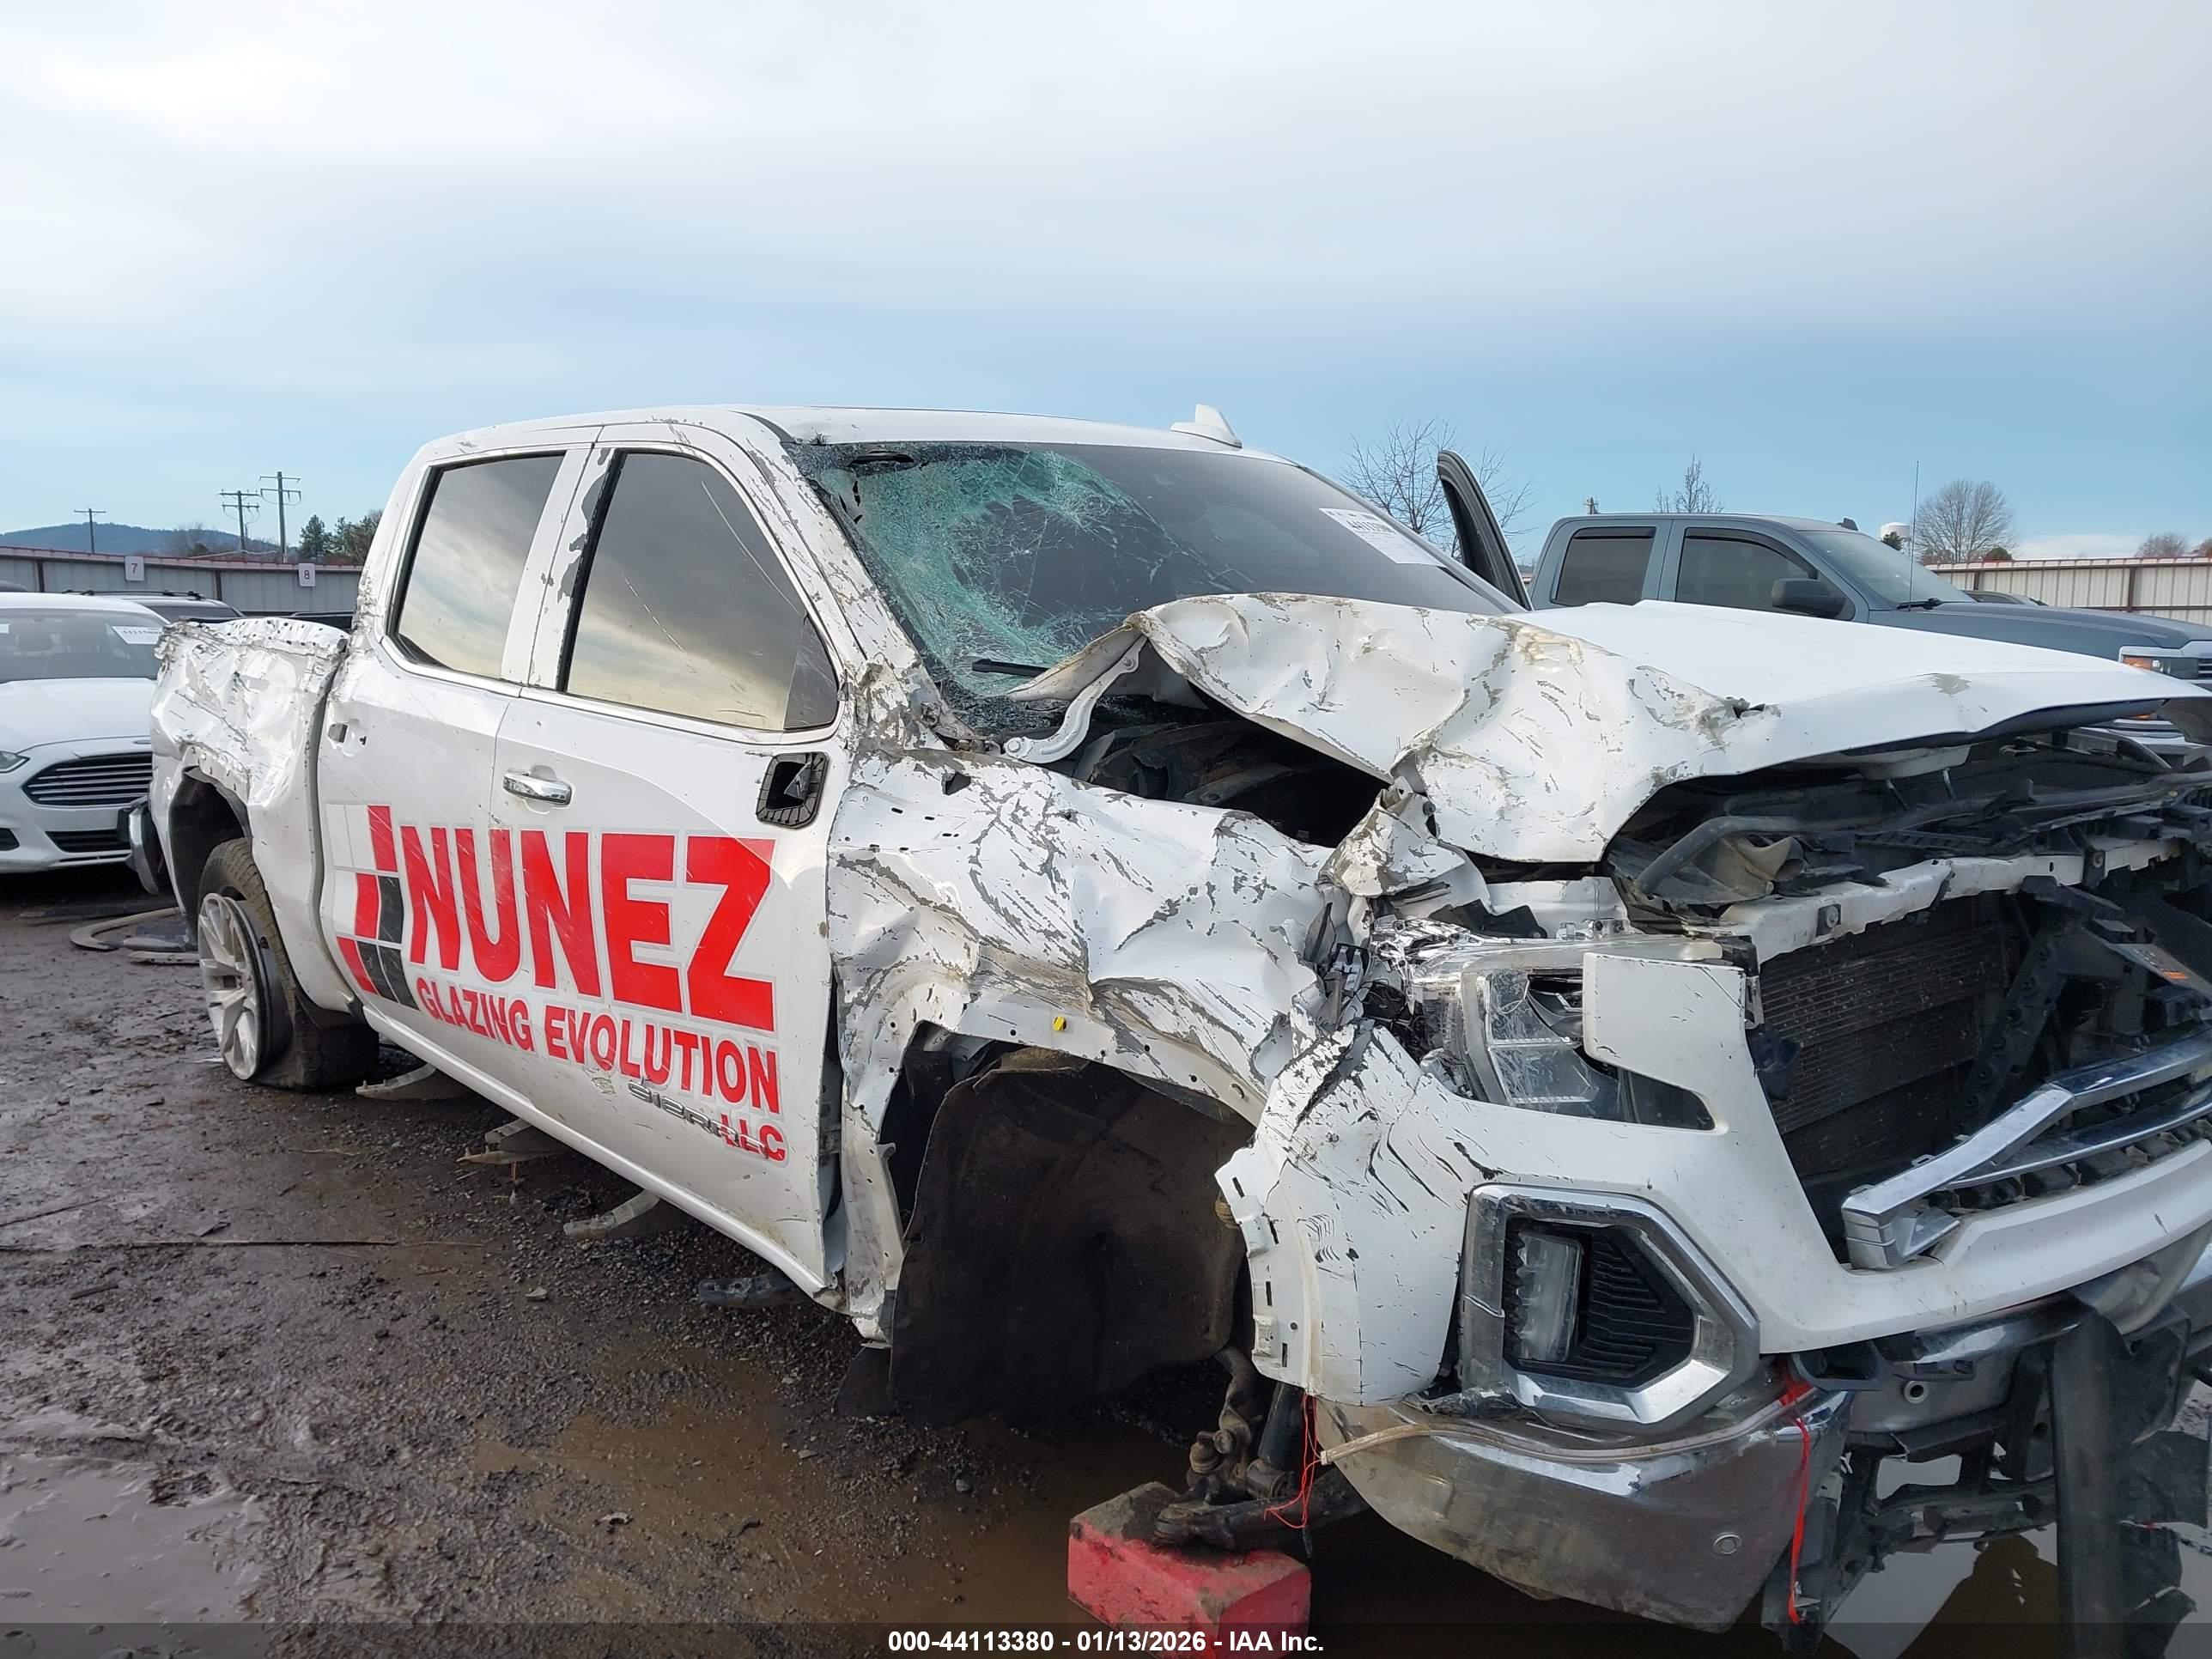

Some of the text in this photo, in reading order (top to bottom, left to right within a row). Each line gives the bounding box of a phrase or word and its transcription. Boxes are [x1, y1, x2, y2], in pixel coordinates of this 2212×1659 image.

[131, 562, 138, 574] 7
[303, 569, 310, 580] 8
[400, 826, 775, 1032] NUNEZ
[416, 977, 780, 1114] GLAZING EVOLUTION
[720, 1113, 786, 1161] LLC
